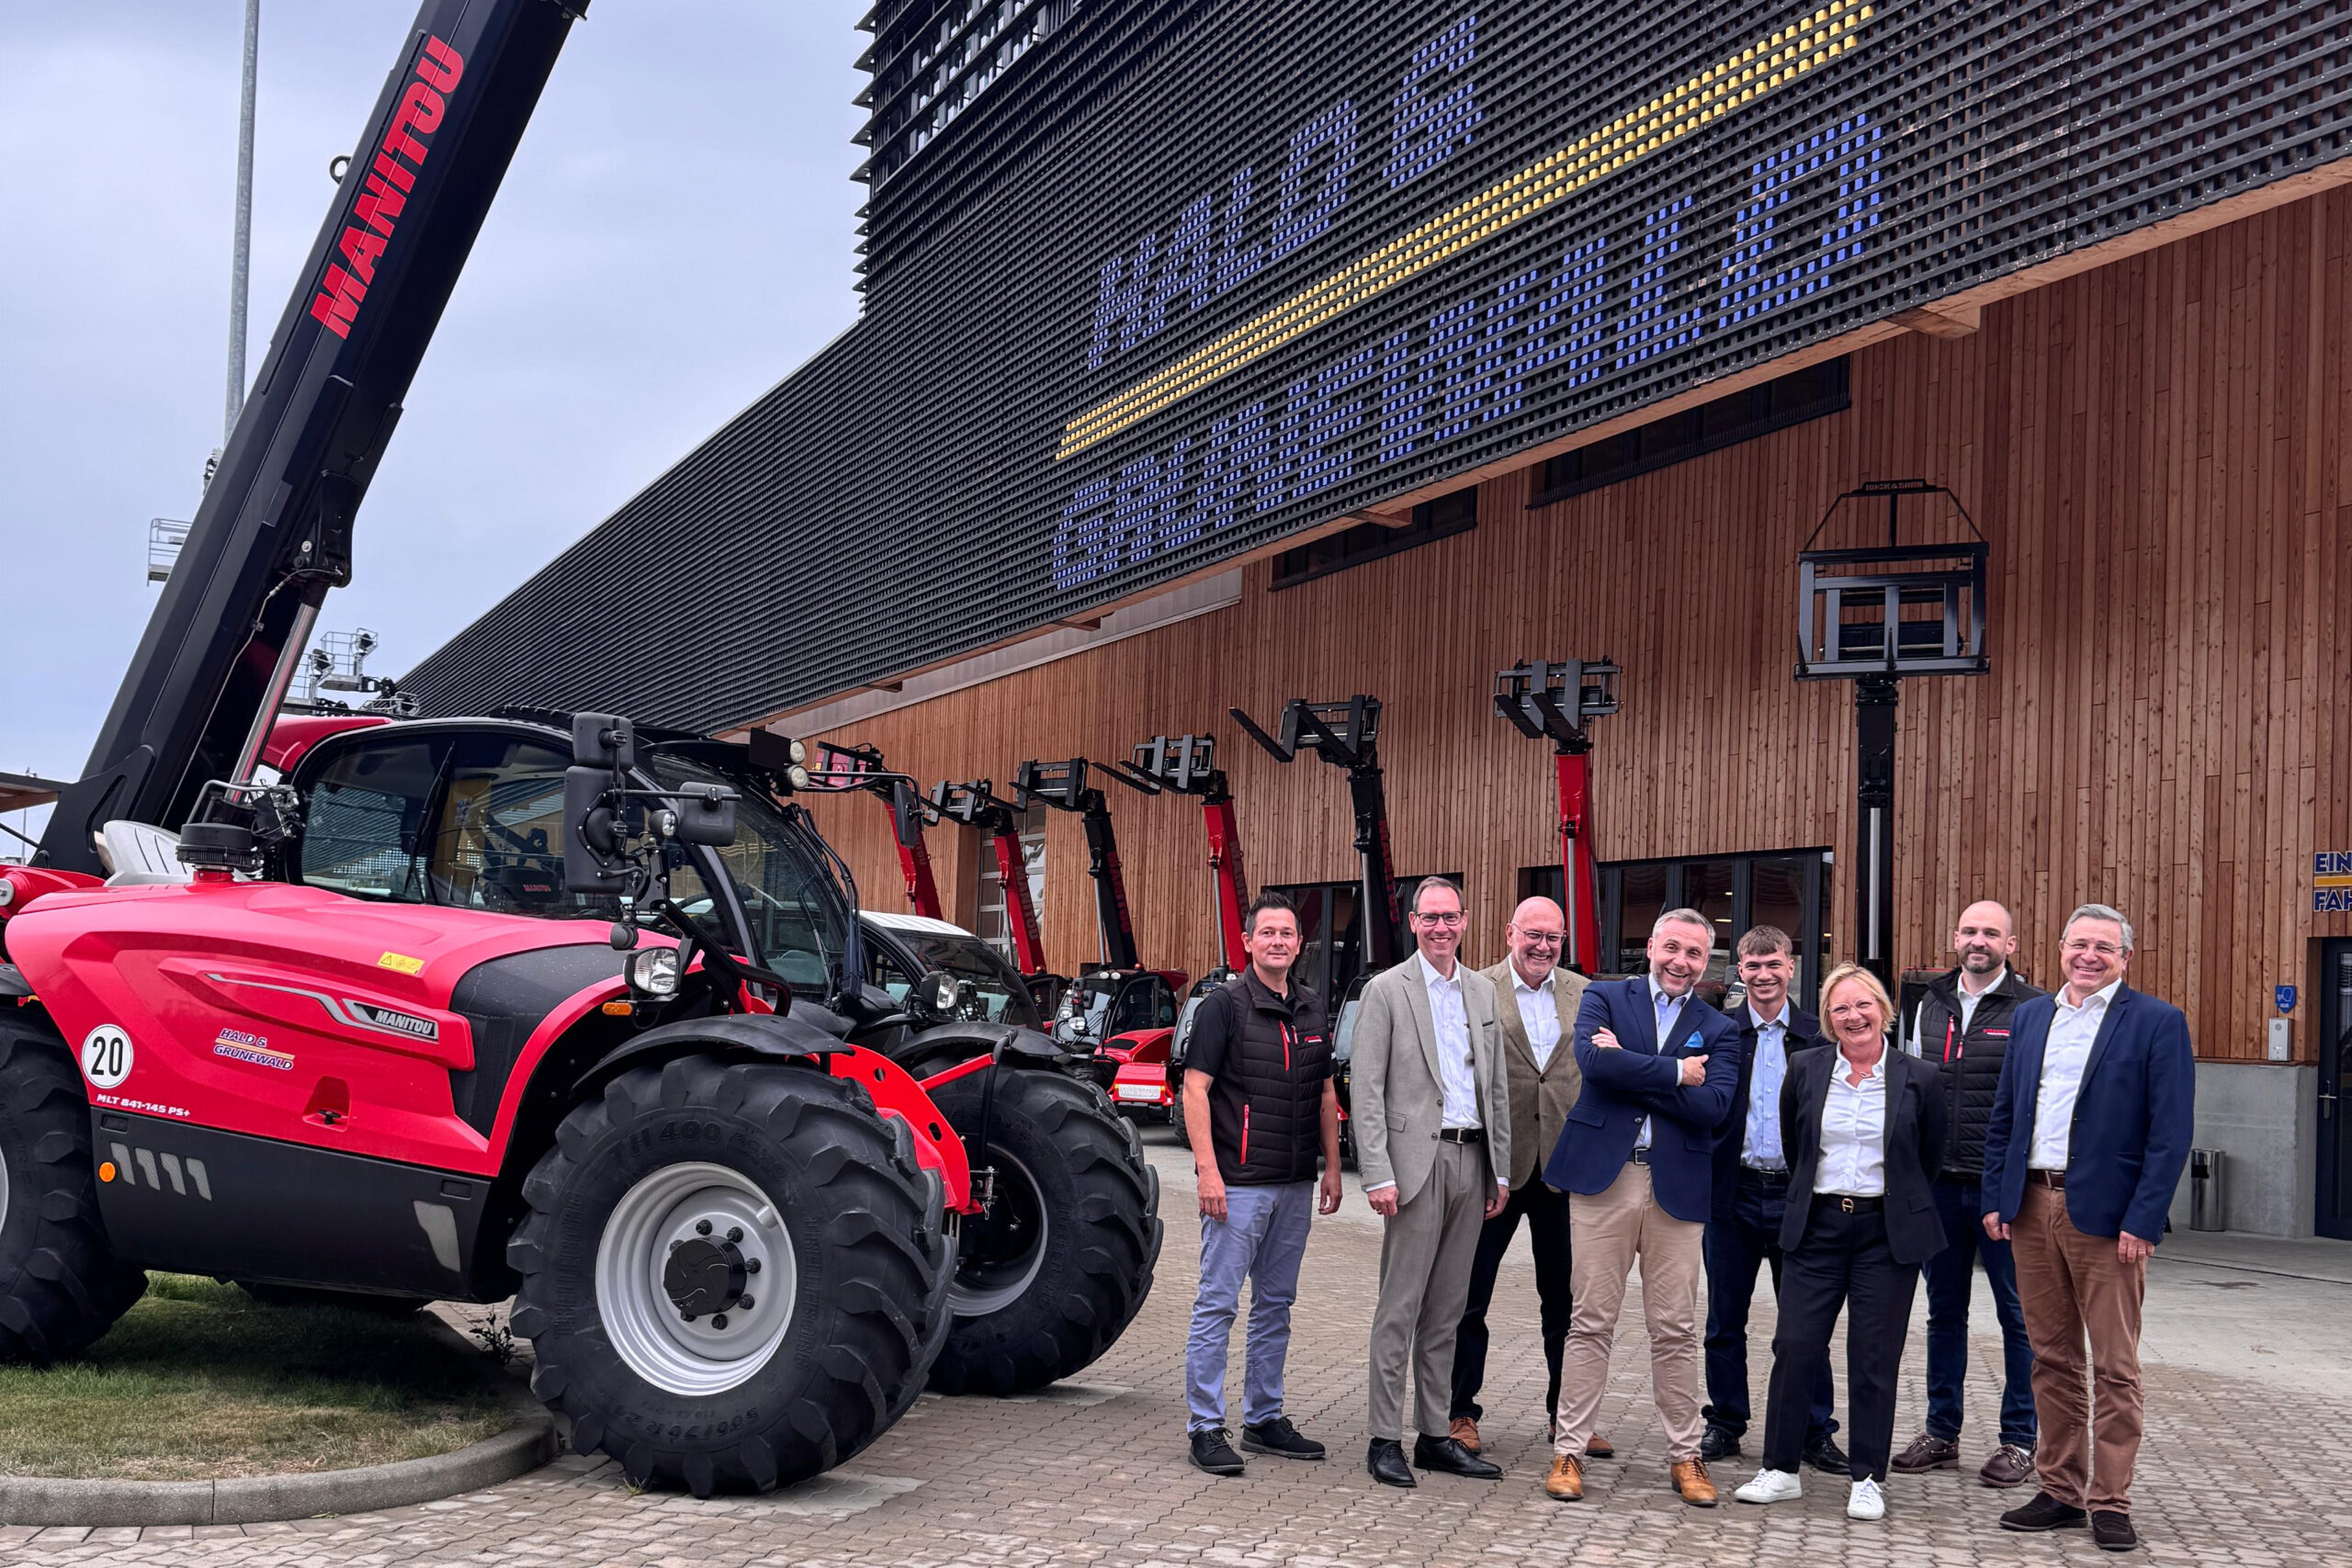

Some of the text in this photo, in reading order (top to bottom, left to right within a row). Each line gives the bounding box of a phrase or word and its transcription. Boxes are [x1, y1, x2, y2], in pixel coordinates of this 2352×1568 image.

[311, 35, 464, 340] MANITOU
[1087, 99, 1360, 370] HALD
[1051, 112, 1883, 591] GRUNEWALD
[375, 1010, 433, 1034] MANITOU
[220, 1028, 267, 1047] HALD &
[91, 1036, 124, 1077] 20
[213, 1044, 294, 1070] GRUNEWALD
[96, 1094, 190, 1117] MLT 841-145 PS+
[659, 1120, 721, 1144] 400
